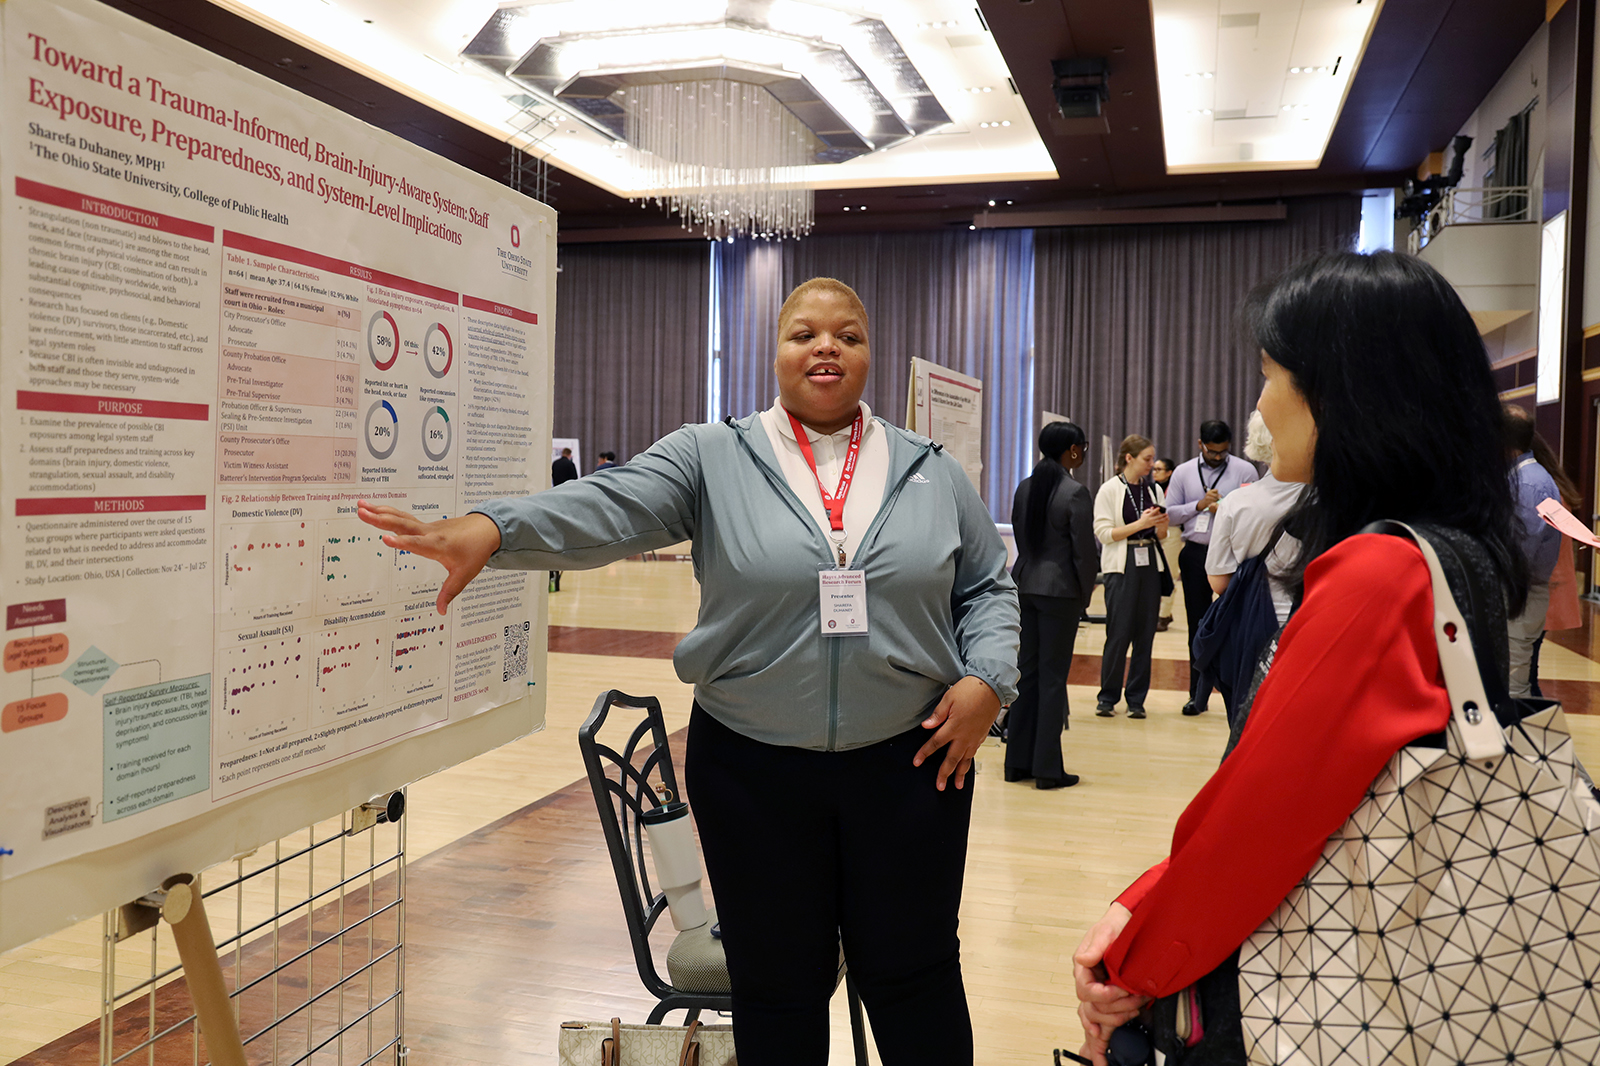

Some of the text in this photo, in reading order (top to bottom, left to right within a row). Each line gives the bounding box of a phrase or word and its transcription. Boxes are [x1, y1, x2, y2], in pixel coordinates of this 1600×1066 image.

[28, 33, 490, 228] Toward a Trauma-Informed, Brain-Injury-Aware System: Staff
[29, 122, 76, 147] Sharefa
[80, 138, 132, 165] Duhaney,
[29, 78, 462, 245] Exposure, Preparedness, and System-Level Implications
[62, 152, 90, 170] Ohio
[93, 162, 121, 179] State
[124, 170, 180, 197] University,
[184, 187, 219, 207] College
[222, 199, 231, 208] of
[233, 200, 259, 217] Public
[262, 209, 288, 225] Health
[82, 199, 158, 227] INTRODUCTION
[227, 253, 245, 264] Table
[253, 260, 276, 271] Sample
[278, 265, 319, 280] Characteristics
[350, 266, 372, 280] RESULTS
[225, 287, 239, 295] Staff
[255, 294, 281, 304] recruited
[283, 298, 295, 306] from
[300, 303, 324, 312] municipal
[249, 302, 262, 310] Ohio
[268, 306, 284, 314] Roles:
[224, 310, 235, 320] City
[271, 318, 286, 327] Office
[228, 325, 252, 334] Advocate
[228, 337, 257, 347] Prosecutor
[377, 336, 391, 347] 58%
[223, 349, 286, 364] County Probation Office
[432, 346, 445, 356] 42%
[227, 376, 283, 388] Pre-Trial Investigator
[226, 389, 280, 400] Pre-Trial Supervisor
[98, 401, 142, 414] PURPOSE
[222, 401, 249, 410] Probation
[275, 405, 302, 414] Supervisors
[69, 434, 95, 442] among
[97, 432, 114, 442] legal
[375, 426, 390, 436] 20%
[430, 430, 443, 439] 16%
[95, 500, 144, 511] METHODS
[222, 495, 233, 504] Fig.
[241, 494, 280, 503] Relationship
[307, 494, 330, 502] Training
[341, 493, 371, 502] Preparedness
[290, 508, 302, 517] (DV)
[26, 522, 78, 532] Questionnaire
[80, 519, 128, 528] administered
[46, 535, 72, 544] groups
[100, 532, 142, 540] participants
[177, 528, 205, 536] questions
[25, 576, 45, 586] Study
[48, 574, 81, 583] Location:
[84, 572, 103, 580] Ohio,
[106, 570, 120, 578] USA
[126, 568, 160, 576] Collection:
[324, 610, 385, 626] Disability Accommodation
[238, 625, 293, 641] Sexual Assault (SA)
[220, 753, 258, 769] Preparedness:
[289, 736, 313, 748] prepared,
[337, 722, 357, 734] prepared,
[386, 706, 402, 718] prepared,
[426, 694, 442, 704] prepared
[117, 759, 141, 770] Training
[142, 751, 166, 762] received
[177, 744, 191, 753] each
[237, 768, 250, 780] point
[252, 759, 279, 772] represents
[292, 751, 303, 759] staff
[304, 745, 326, 755] member
[116, 763, 160, 781] domain (hours)
